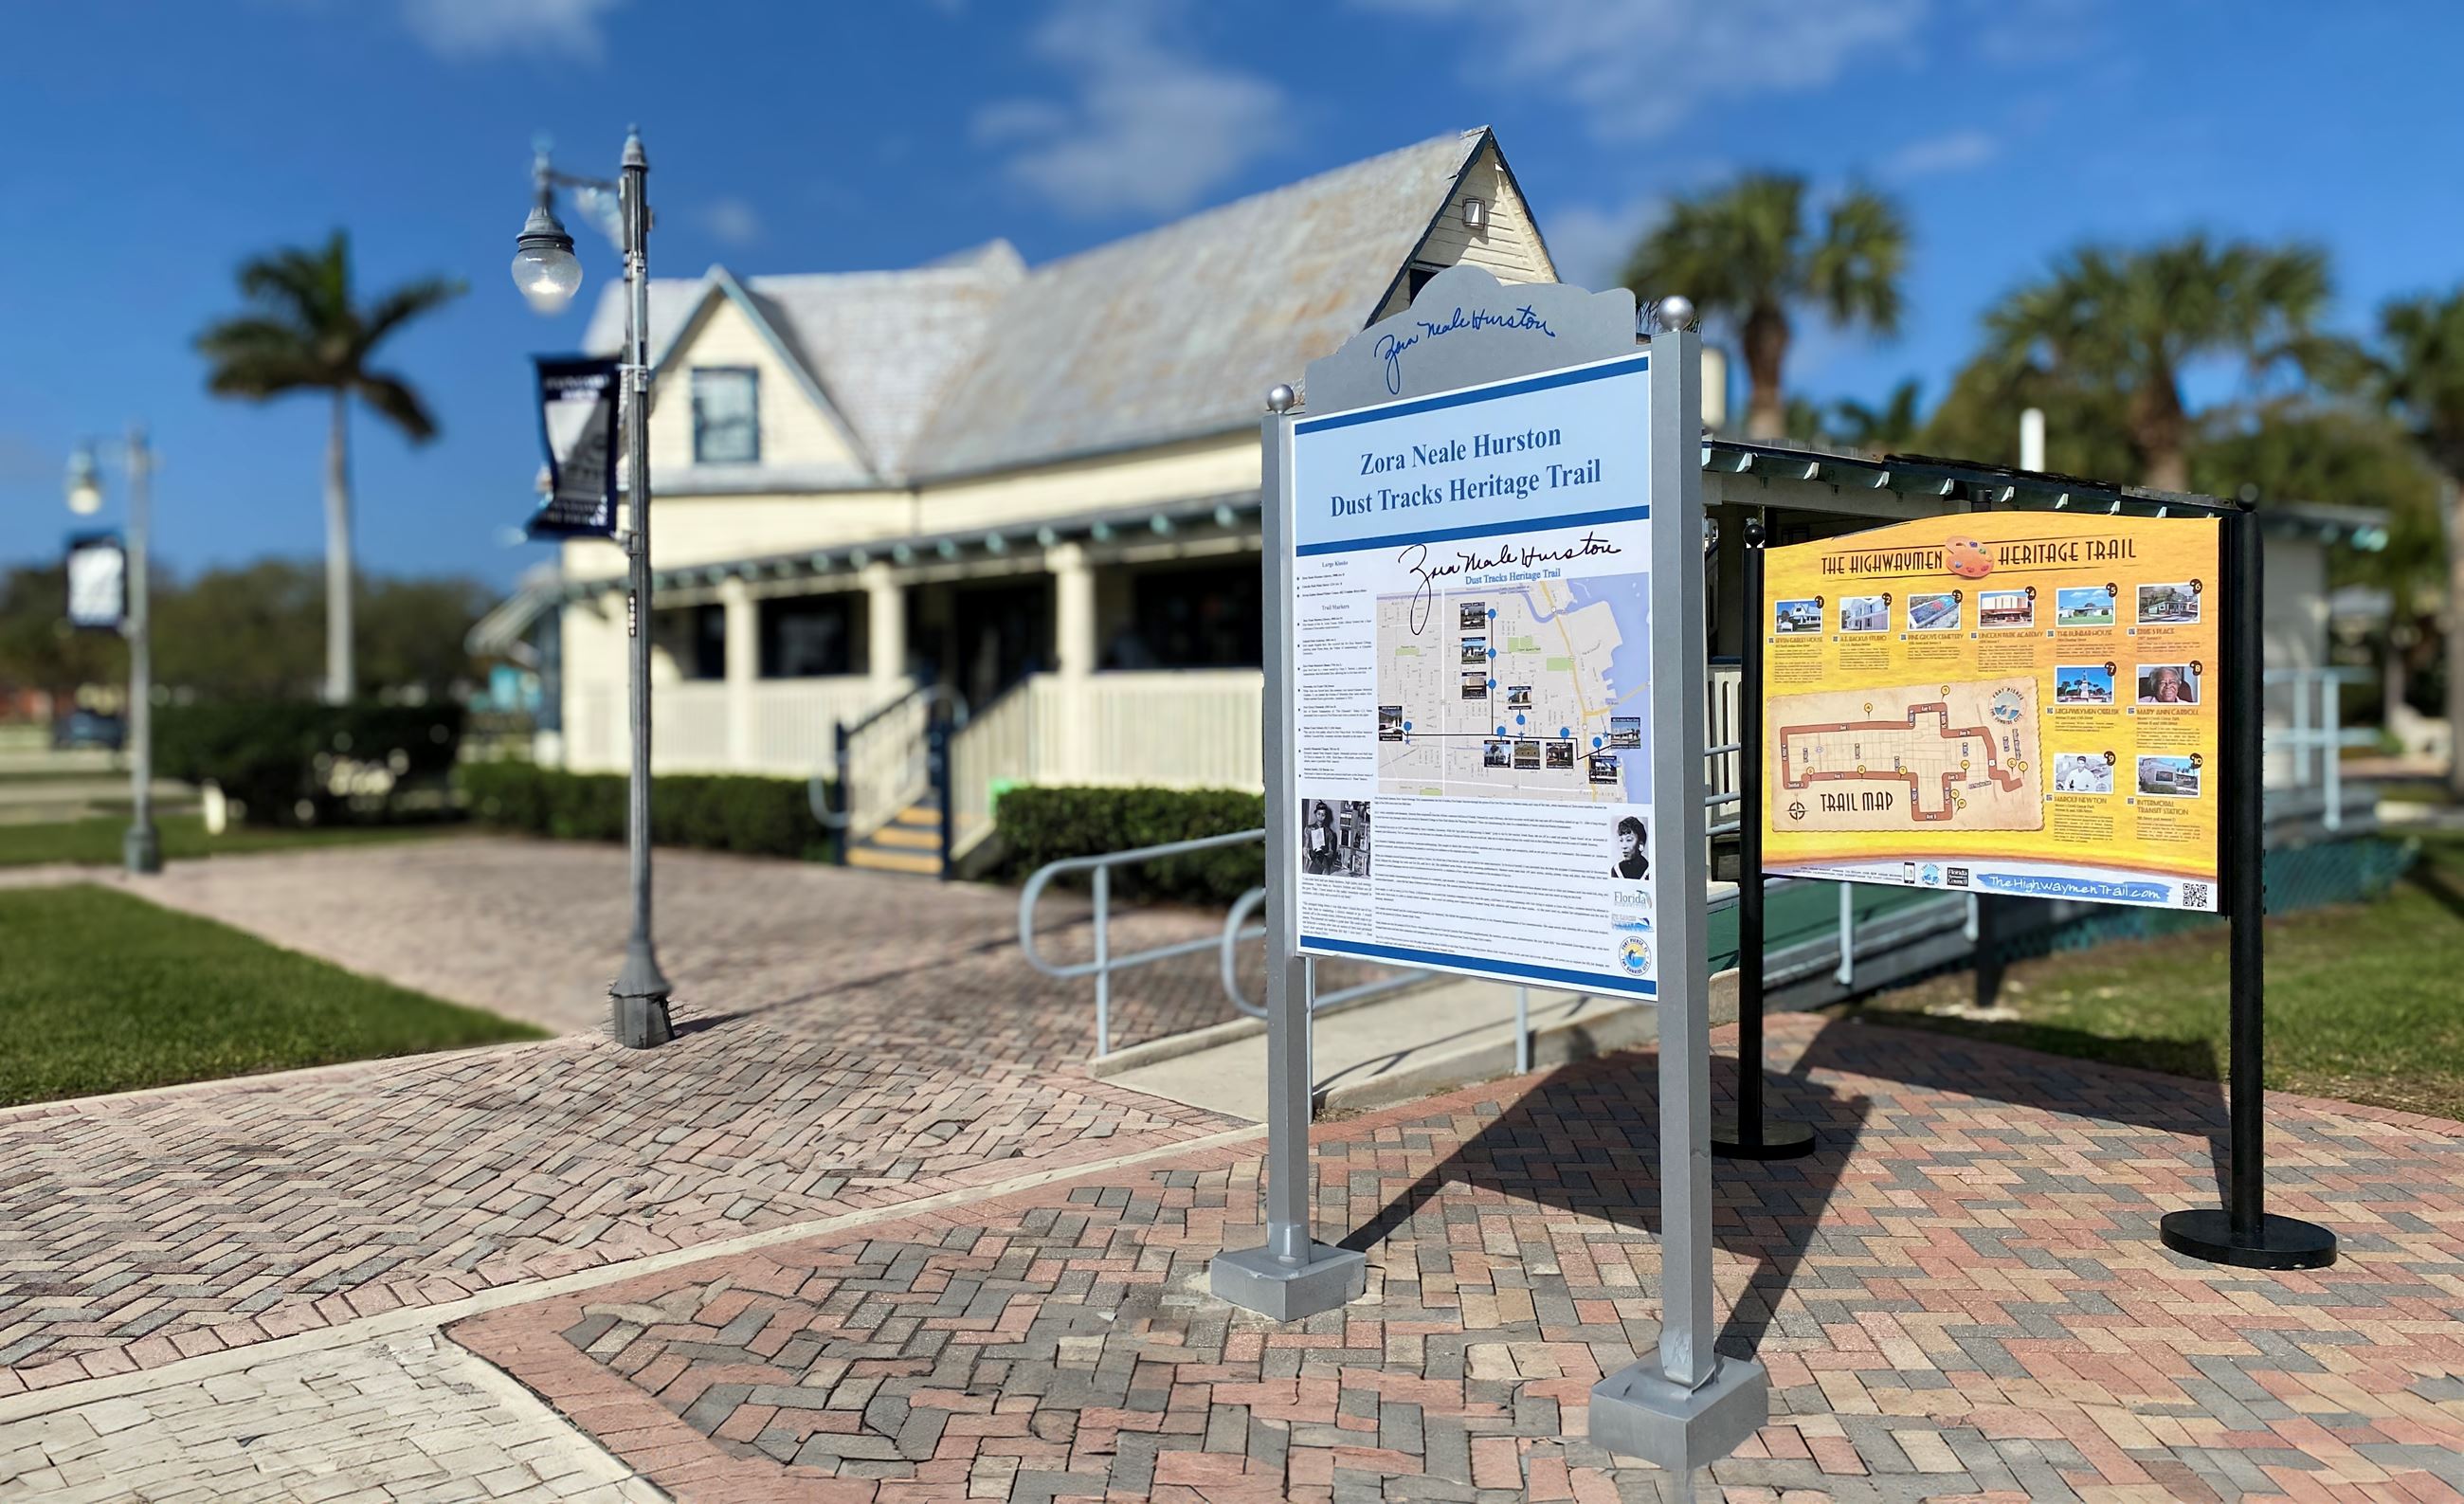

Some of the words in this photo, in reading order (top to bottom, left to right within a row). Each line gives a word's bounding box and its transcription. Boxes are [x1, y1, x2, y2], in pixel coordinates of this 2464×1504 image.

[1374, 335, 1419, 395] Zora
[1418, 307, 1470, 338] Neale
[1472, 304, 1556, 337] Hurston
[1360, 453, 1405, 476] Zora
[1412, 439, 1466, 468] Neale
[1474, 427, 1561, 459] Hurston
[1331, 492, 1372, 517] Dust
[1377, 483, 1441, 511] Tracks
[1449, 473, 1540, 501] Heritage
[1546, 459, 1601, 489] Trail
[1457, 544, 1517, 572] Neale
[1522, 531, 1622, 568] Hurston
[1821, 557, 1845, 575] THE
[1849, 552, 1943, 573] HIGHWAYMEN
[1999, 544, 2078, 566] HERITAGE
[2086, 538, 2137, 561] TRAIL
[1465, 576, 1481, 585] Dust
[1483, 573, 1507, 583] Tracks
[1509, 571, 1541, 583] Heritage
[1543, 569, 1561, 578] Trail
[1821, 792, 1857, 811] TRAIL
[1862, 791, 1893, 810] MAP
[1614, 892, 1646, 905] Florida
[1989, 876, 2162, 899] TheHighwaymenTrail.com
